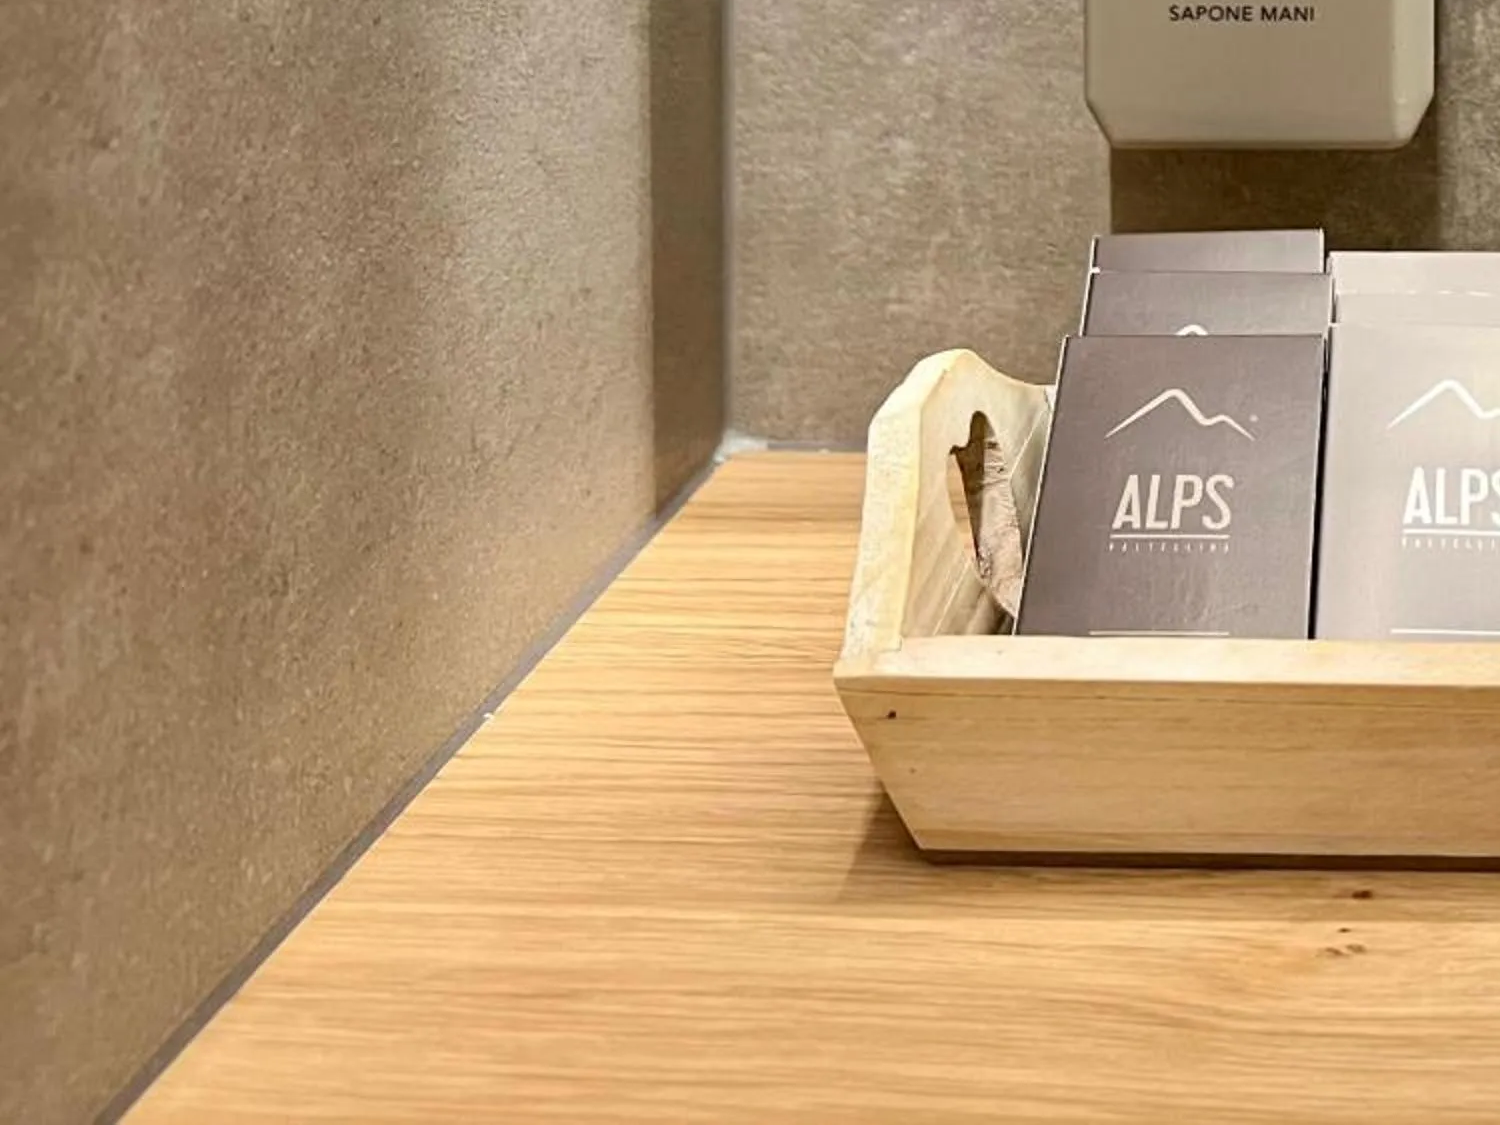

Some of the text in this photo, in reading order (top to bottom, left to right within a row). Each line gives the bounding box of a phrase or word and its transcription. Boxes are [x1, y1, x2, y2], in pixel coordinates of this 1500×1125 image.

[1169, 5, 1315, 22] SAPONE MANI
[1111, 474, 1234, 530] ALPS
